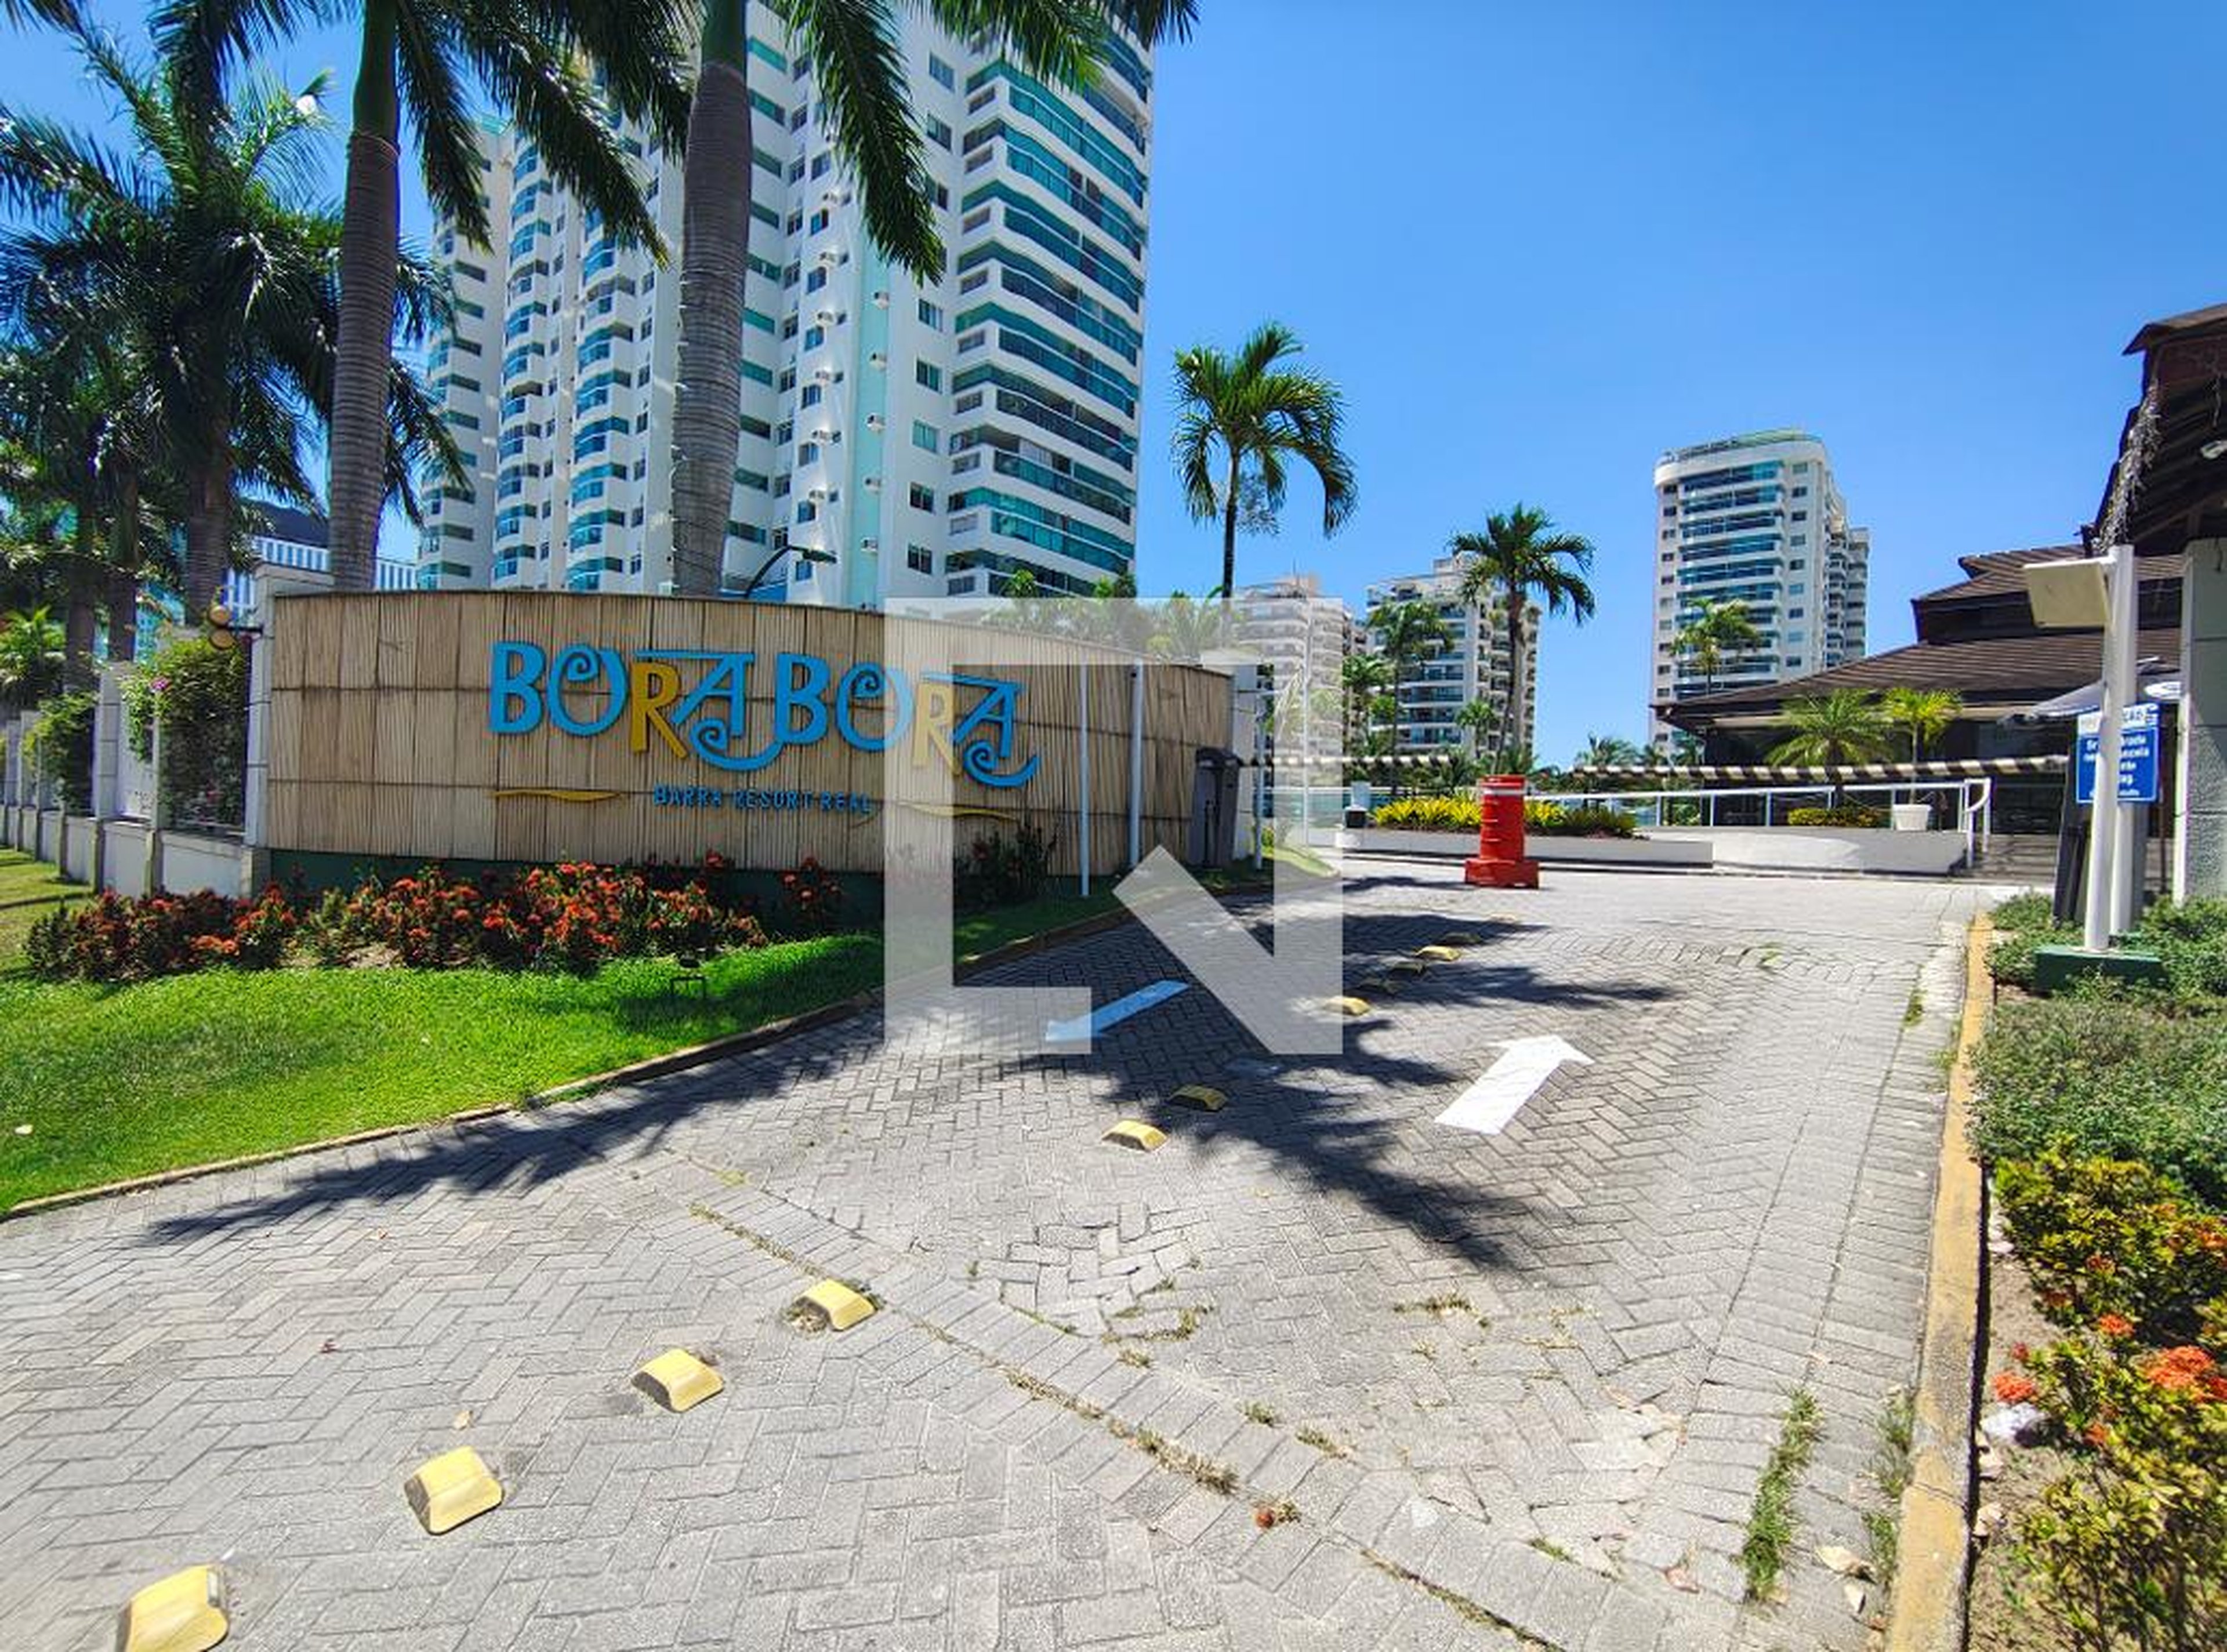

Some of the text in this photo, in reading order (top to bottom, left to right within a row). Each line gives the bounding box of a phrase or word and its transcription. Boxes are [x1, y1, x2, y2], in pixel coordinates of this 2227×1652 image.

[488, 640, 1039, 788] BORA BORA
[654, 783, 722, 808] BARRA
[734, 788, 813, 810] RESORT
